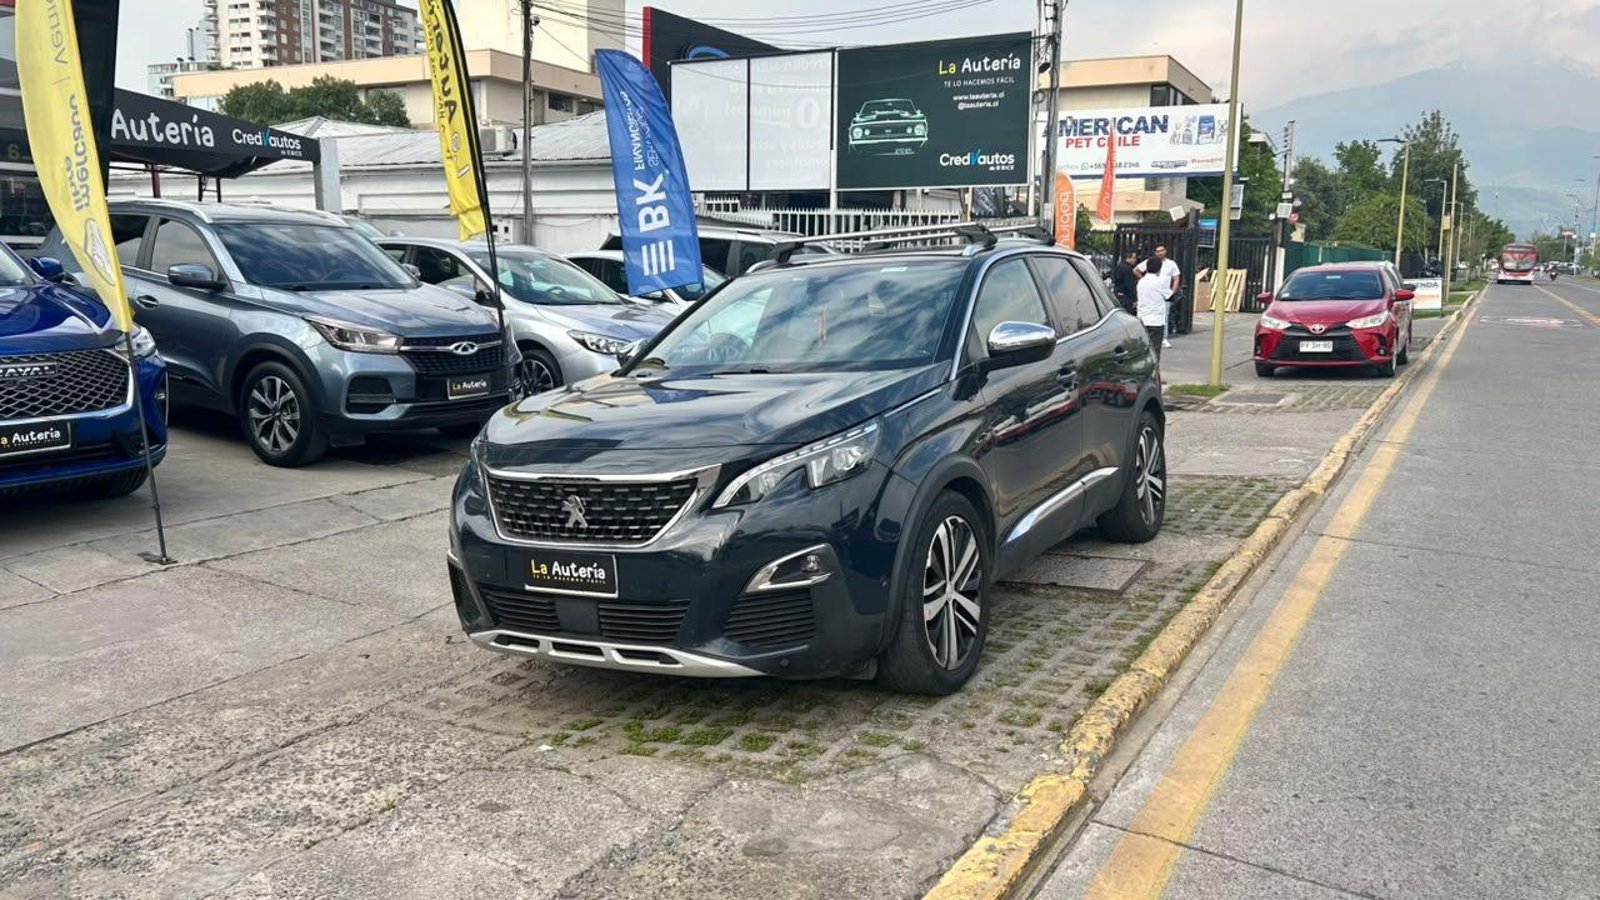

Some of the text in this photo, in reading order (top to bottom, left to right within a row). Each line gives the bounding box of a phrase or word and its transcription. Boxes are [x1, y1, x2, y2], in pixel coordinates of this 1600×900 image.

[938, 52, 1021, 75] La Autería
[111, 108, 215, 147] Autería
[1043, 114, 1169, 137] MERCAN
[1065, 137, 1093, 149] PET
[531, 559, 548, 575] La
[552, 561, 606, 580] Autería
